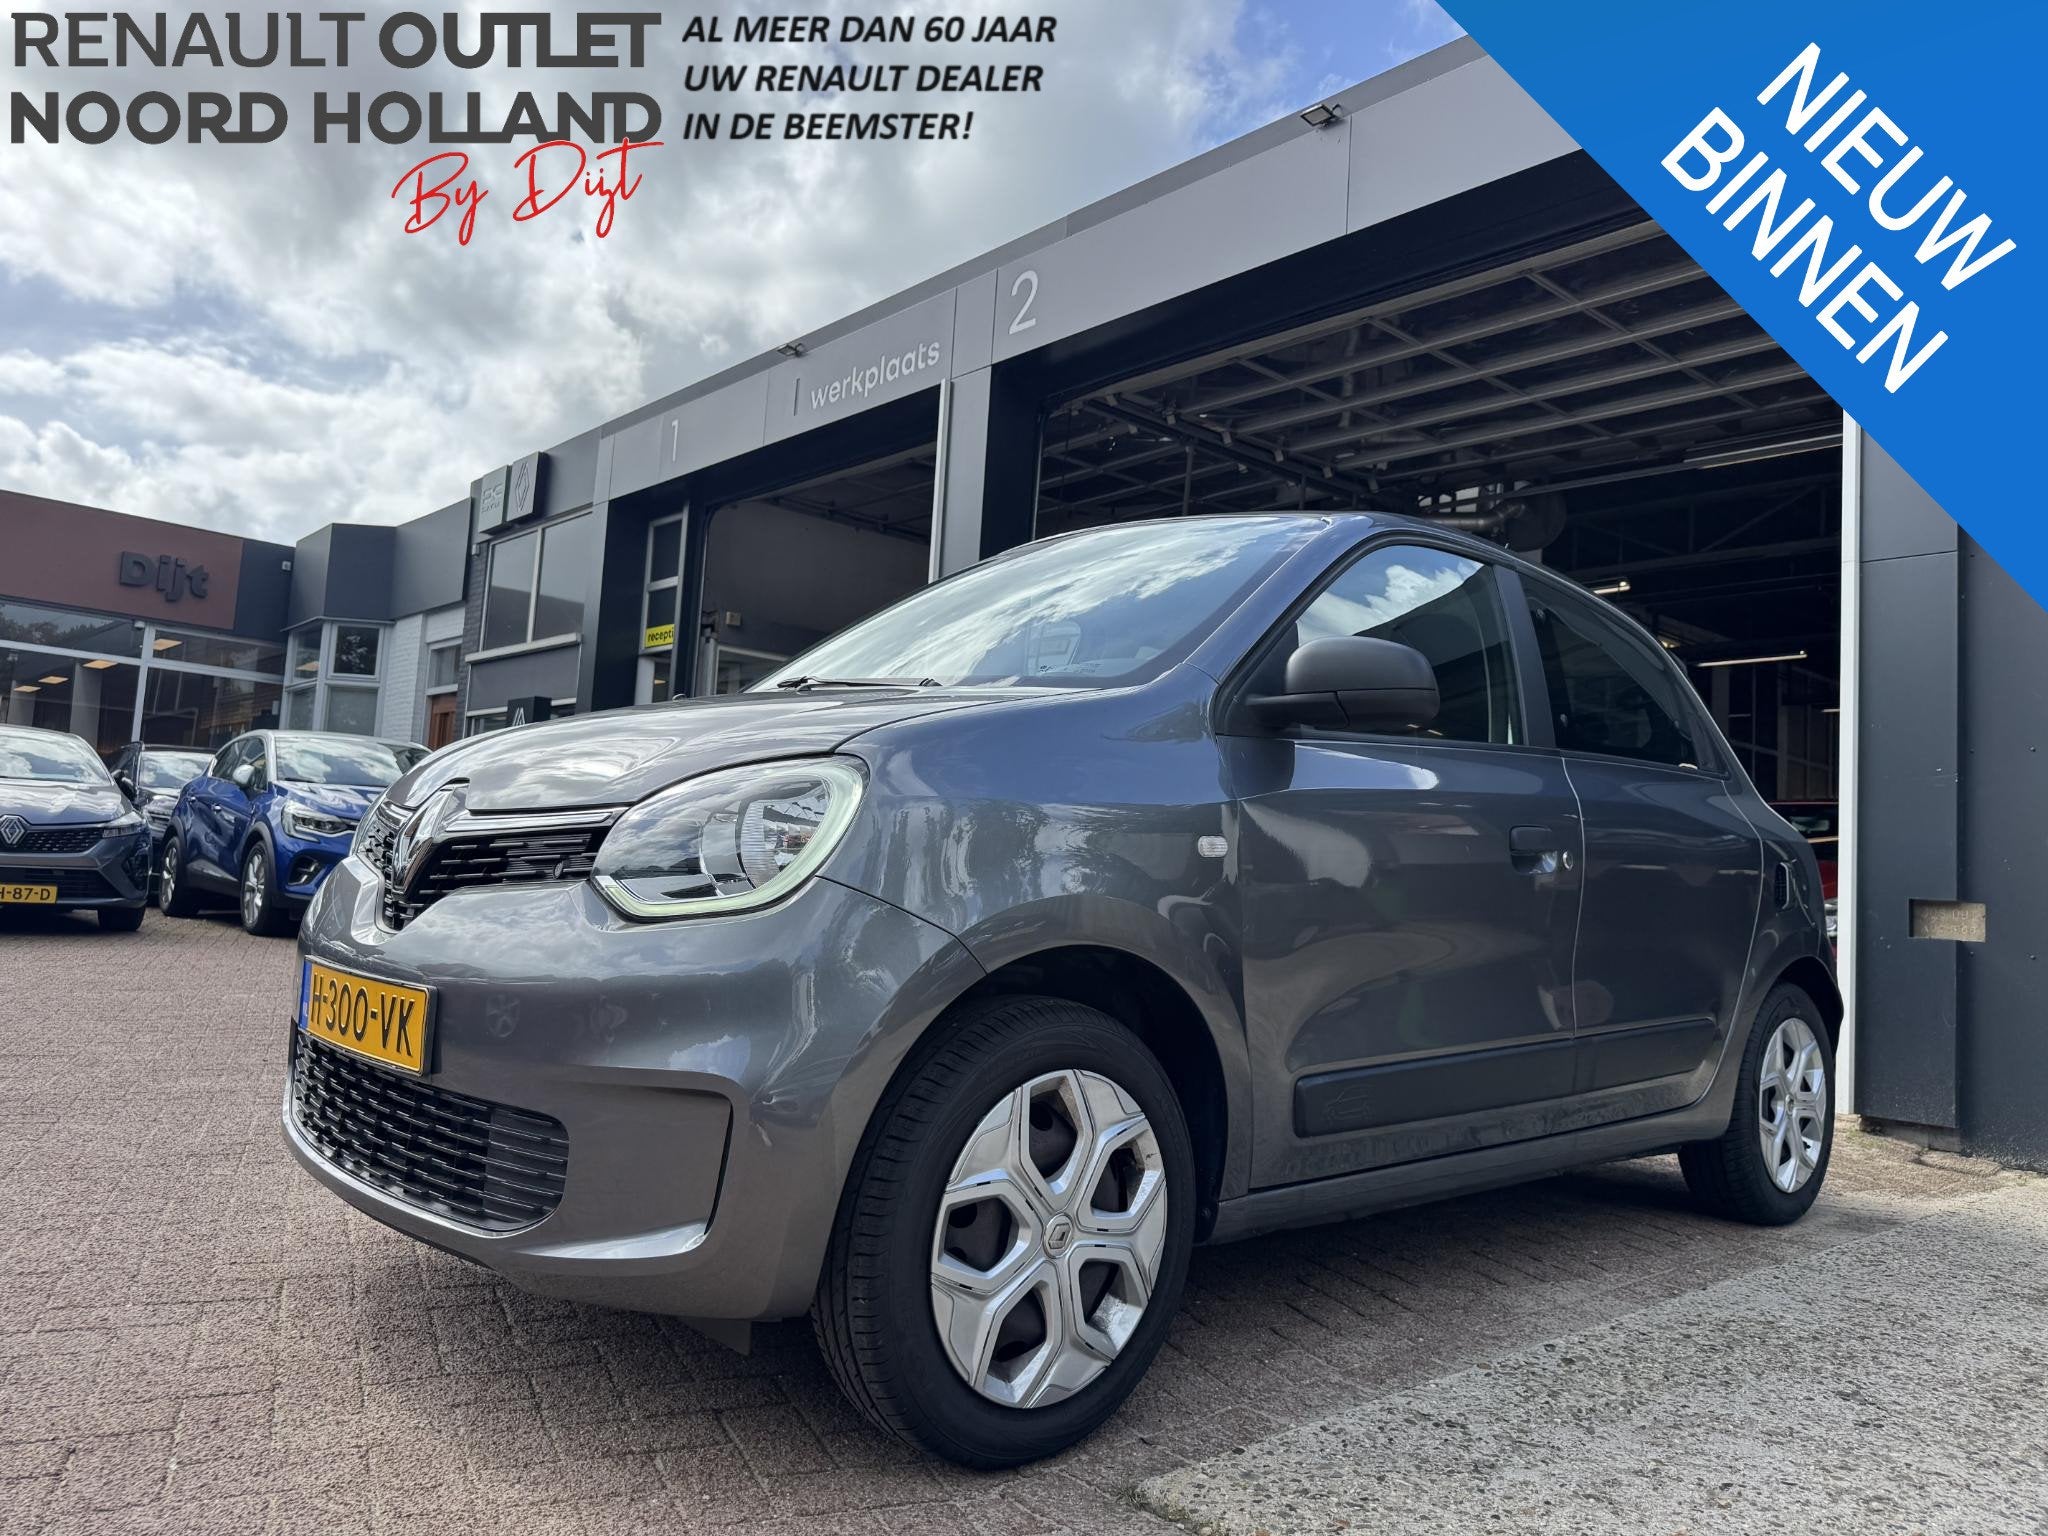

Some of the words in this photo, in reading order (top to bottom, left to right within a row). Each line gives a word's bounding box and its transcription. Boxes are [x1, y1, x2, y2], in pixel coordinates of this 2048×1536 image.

[1008, 269, 1039, 335] 2
[810, 340, 941, 412] werkplaats
[670, 420, 679, 462] 1
[119, 550, 210, 601] Dijt
[310, 972, 416, 1057] H-300-VK
